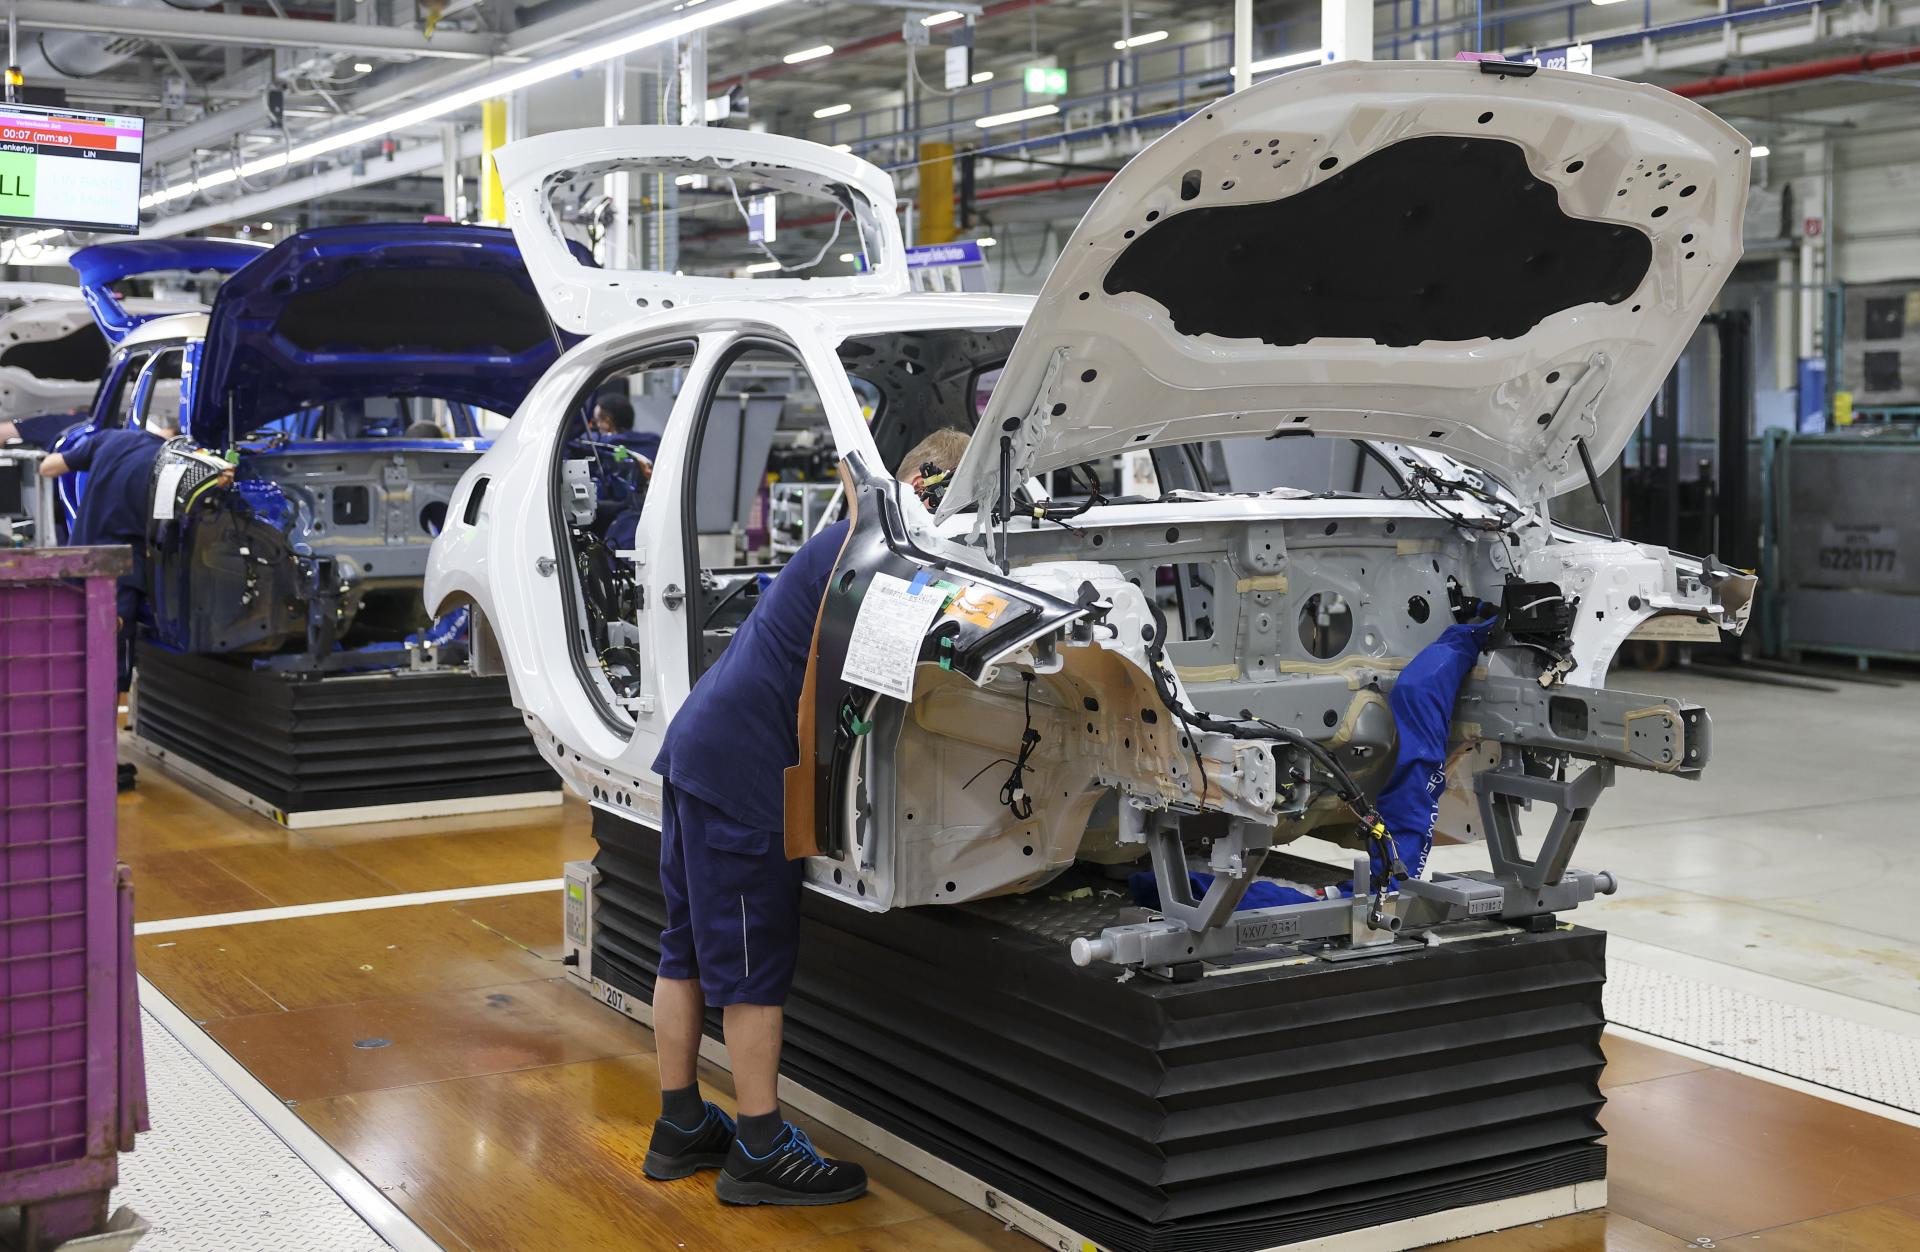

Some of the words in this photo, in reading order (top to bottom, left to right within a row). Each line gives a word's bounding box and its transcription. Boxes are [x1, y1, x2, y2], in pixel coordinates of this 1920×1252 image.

[3, 128, 31, 140] 00:07
[33, 132, 72, 145] (mm:ss)
[0, 142, 35, 154] Lenkertyp
[83, 150, 97, 158] LIN
[0, 174, 30, 197] LL
[606, 987, 622, 1010] 207
